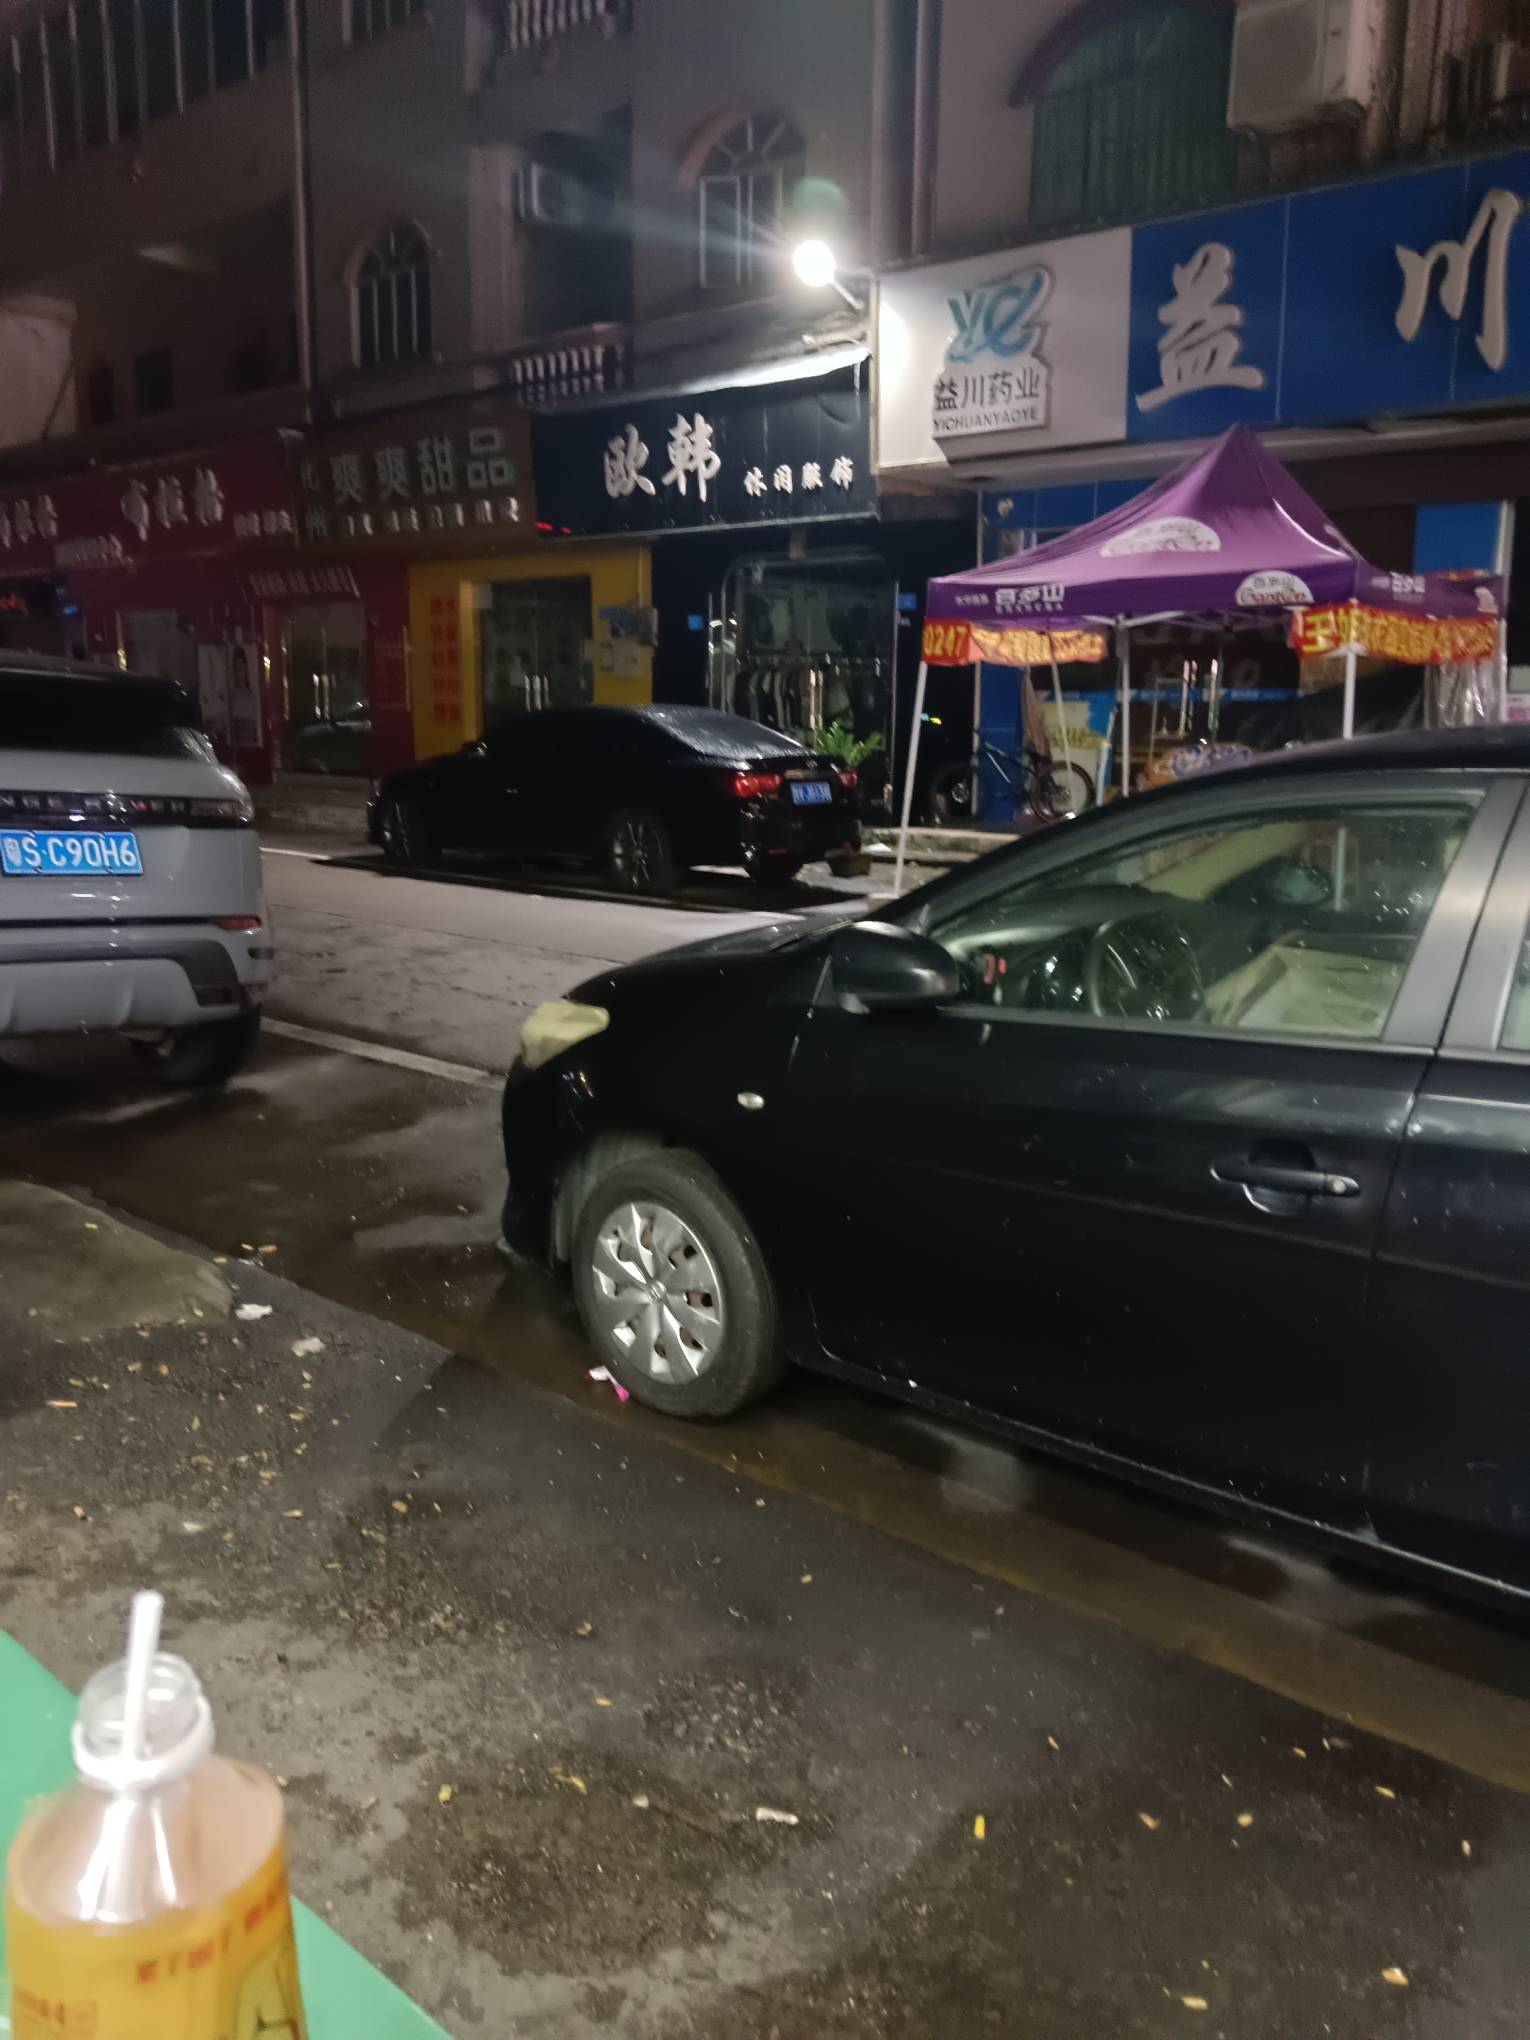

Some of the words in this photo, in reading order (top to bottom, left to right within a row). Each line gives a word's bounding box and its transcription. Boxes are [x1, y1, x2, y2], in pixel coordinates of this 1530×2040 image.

[935, 366, 1040, 412] 益川药业
[932, 405, 1041, 434] YICHUANYAOYE
[604, 412, 721, 503] 欧韩
[922, 624, 968, 657] 0247
